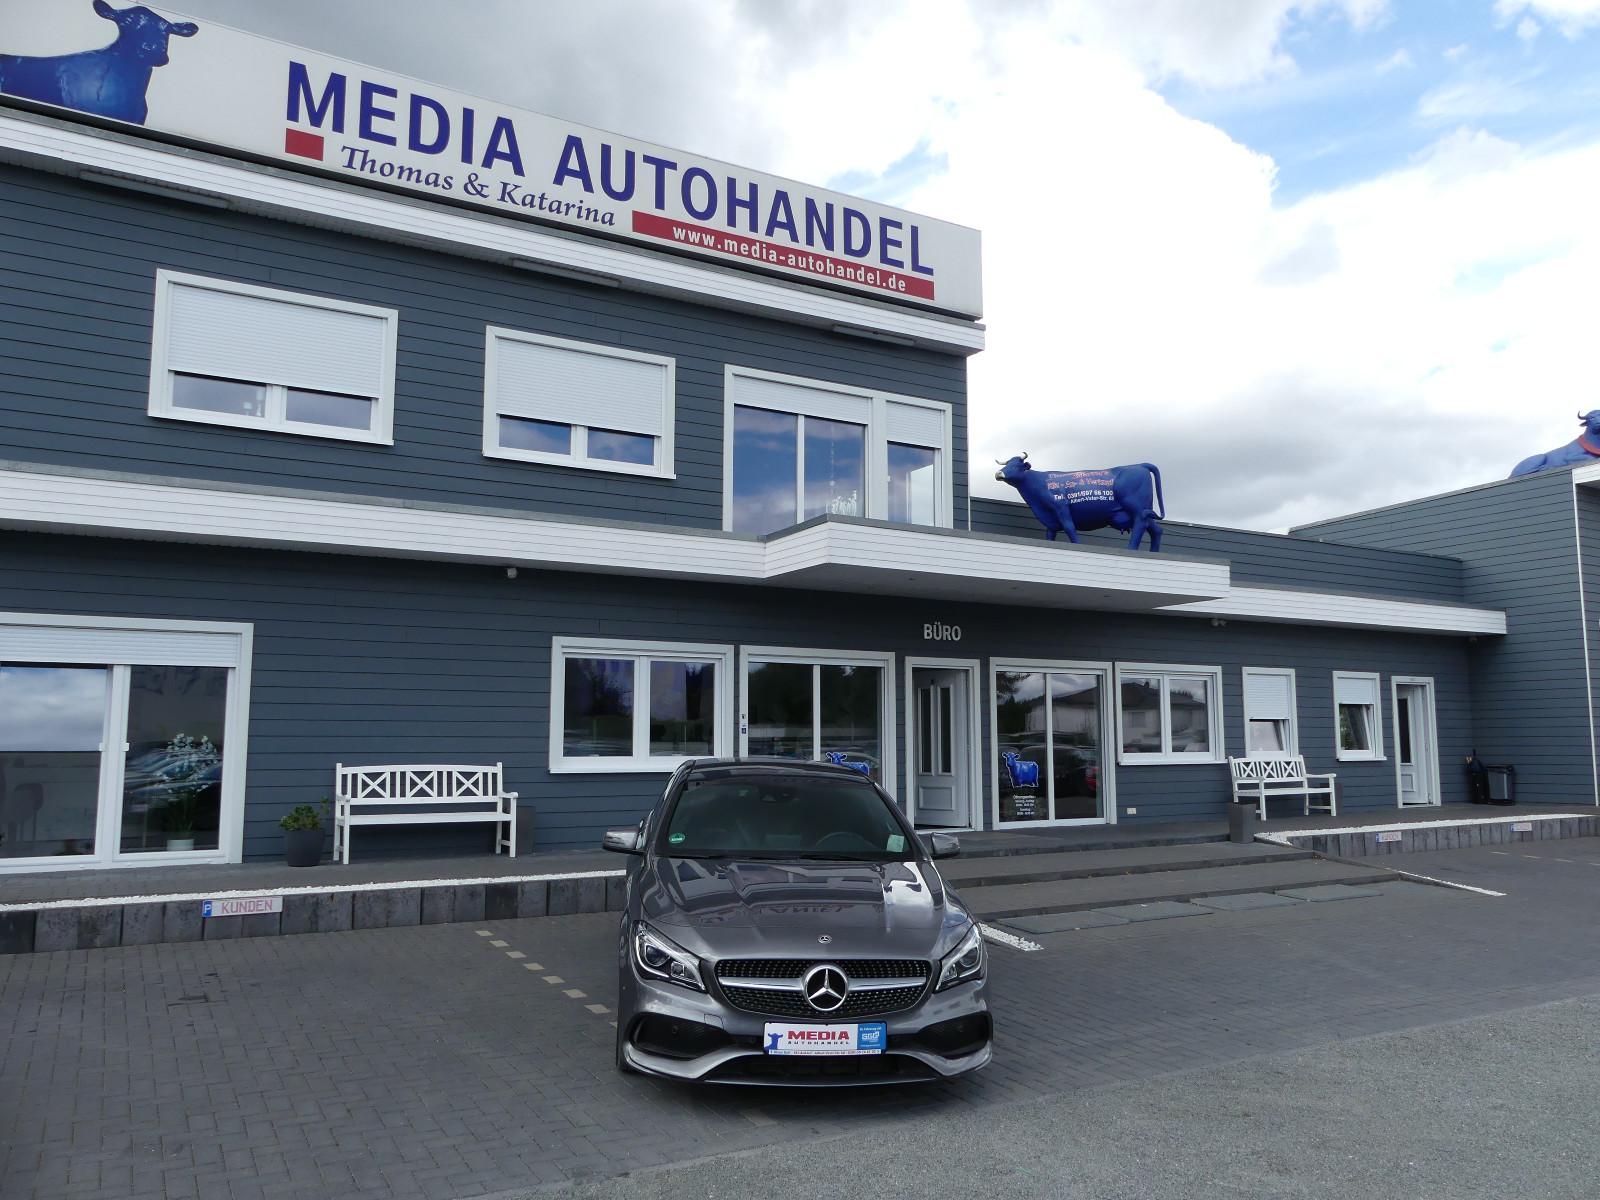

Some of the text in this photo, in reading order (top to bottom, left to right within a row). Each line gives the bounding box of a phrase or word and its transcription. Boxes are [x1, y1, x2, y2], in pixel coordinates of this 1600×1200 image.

[286, 60, 935, 276] MEDIA AUTOHANDEL
[341, 145, 616, 227] Thomas & Katarina
[672, 224, 907, 292] www.media-autohandel.de
[923, 621, 962, 641] BÜRO
[204, 899, 273, 916] P KUNDEN
[787, 1030, 850, 1040] MEDIA
